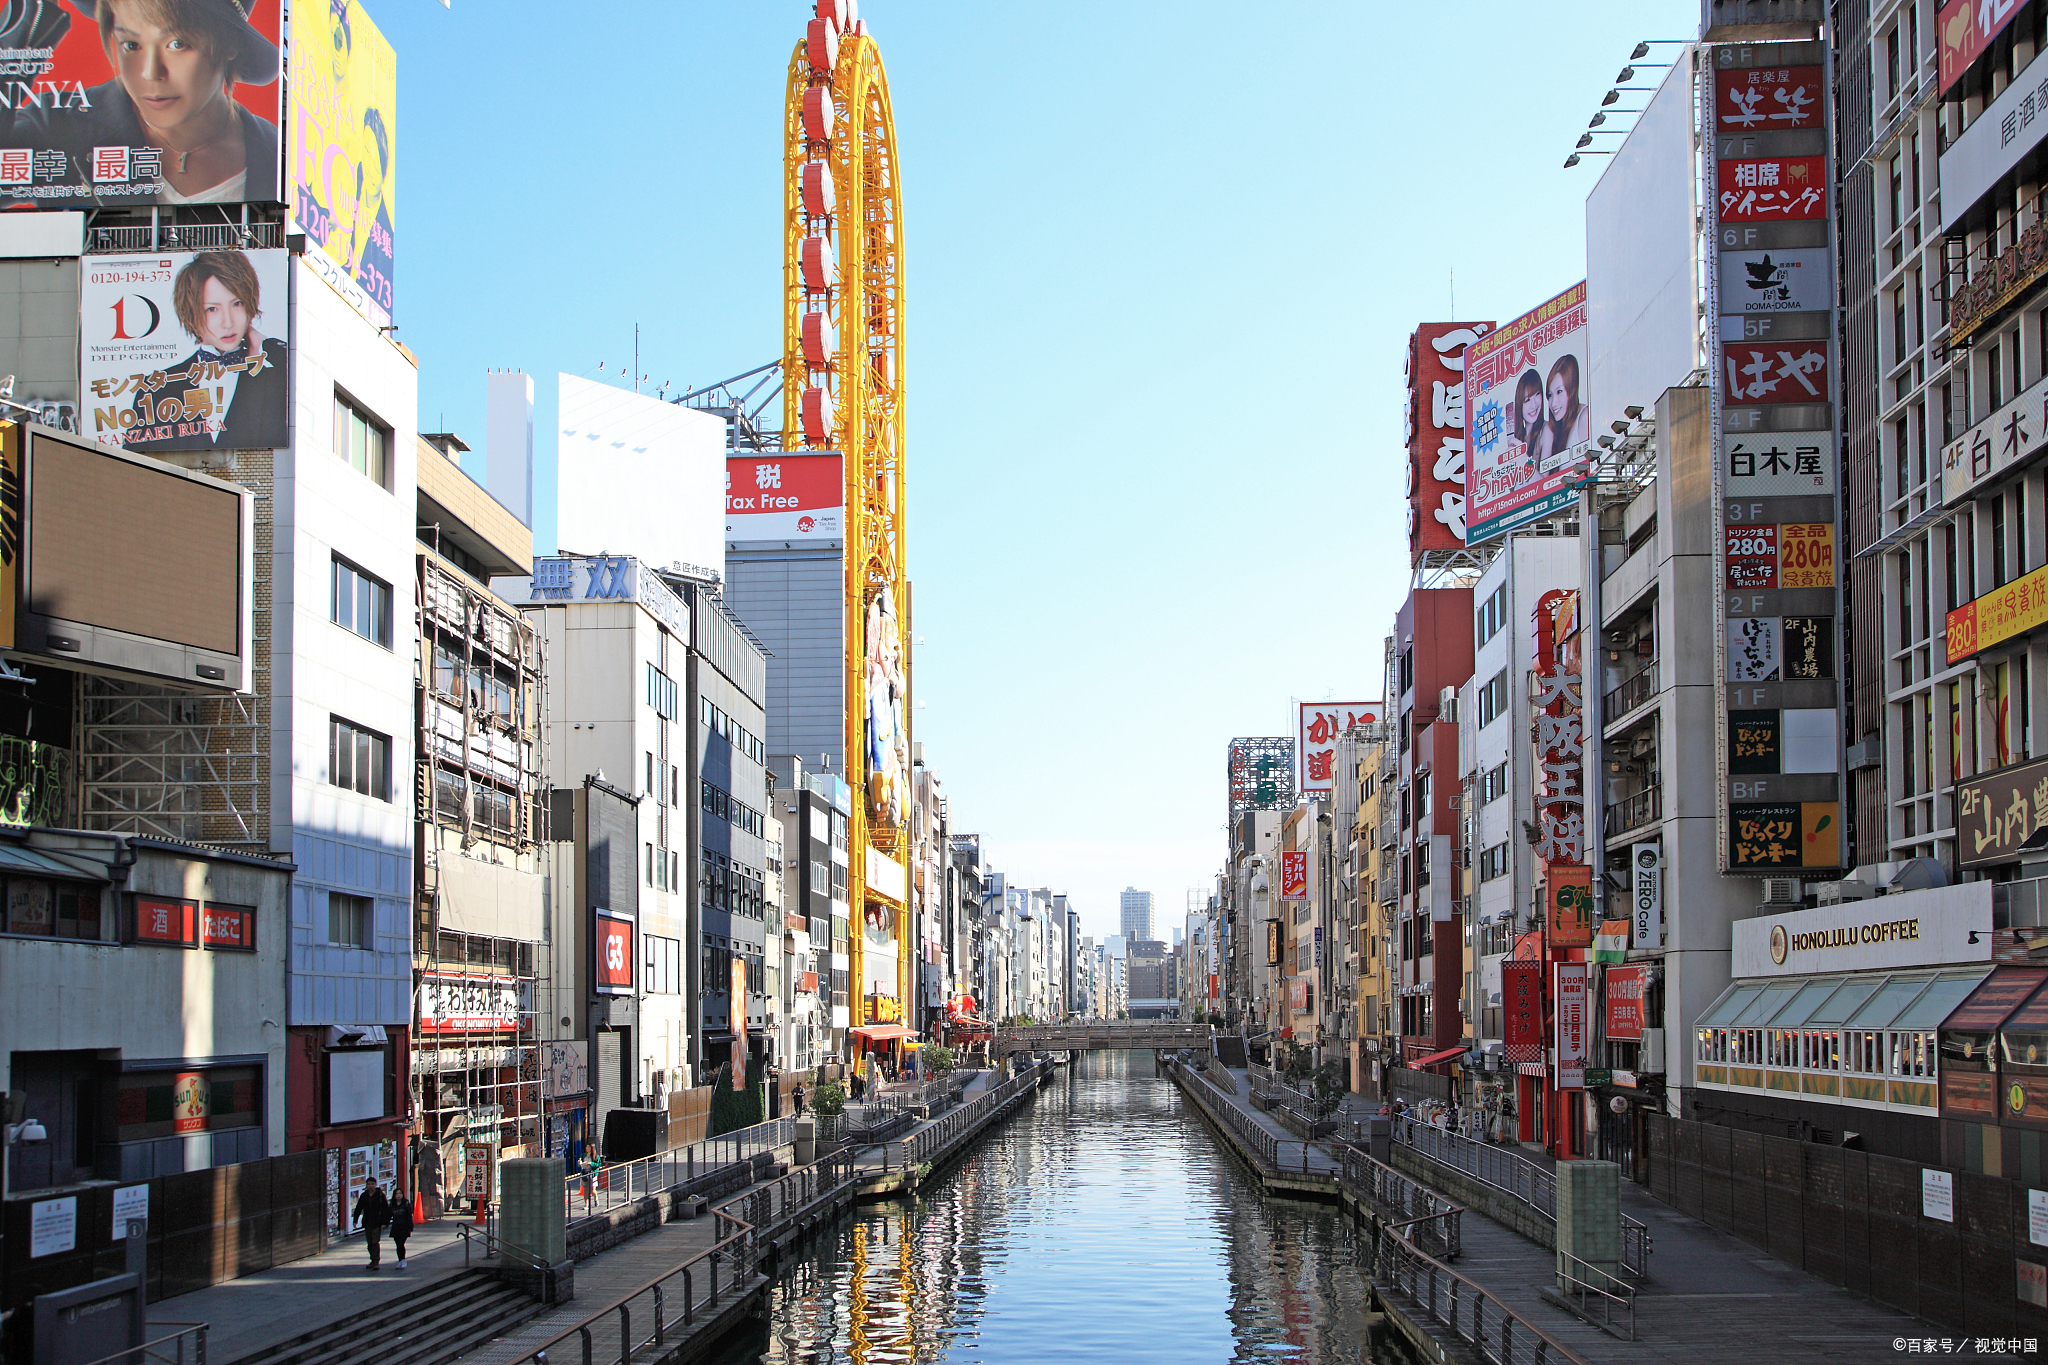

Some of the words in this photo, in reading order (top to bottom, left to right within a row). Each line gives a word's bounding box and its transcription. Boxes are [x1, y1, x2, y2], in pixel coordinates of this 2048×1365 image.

[1747, 70, 1790, 84] 居楽屋
[0, 149, 67, 182] 最幸
[94, 147, 163, 182] 最高
[1735, 162, 1780, 187] 相席
[94, 183, 165, 197] のホストクラブ
[1720, 187, 1825, 217] ダイニング
[91, 270, 172, 284] 0120-194-373
[1745, 301, 1802, 311] DOMA-DOMA
[1745, 319, 1772, 337] 5F
[91, 354, 127, 362] DEEP
[129, 352, 178, 360] GROUP
[124, 343, 177, 351] Entertainment
[90, 351, 268, 399] モンスターグループ
[1472, 336, 1537, 397] 高収入
[1726, 349, 1826, 400] はや
[94, 386, 224, 432] No.1の男!
[98, 424, 174, 446] KANZAKI
[178, 419, 227, 437] RUKA
[1730, 443, 1824, 477] 白木屋
[1945, 441, 1964, 471] 4F
[761, 493, 799, 509] Free
[1477, 486, 1539, 519] http://15navi.com/
[1728, 528, 1774, 537] ドリンク全品
[1785, 525, 1827, 538] 全品
[1727, 538, 1776, 556] 280円
[1781, 539, 1832, 569] 280円
[673, 560, 719, 578] 意匠作成中
[1730, 565, 1773, 579] 居心伝
[1782, 570, 1833, 587] 鳥貴族
[2004, 574, 2046, 623] 鳥貴族
[1785, 619, 1800, 630] 2F
[1947, 619, 1977, 655] 280円
[1802, 618, 1819, 678] 山内農場
[1737, 728, 1772, 743] びっくり
[1531, 664, 1583, 862] 大阪王将
[1735, 743, 1774, 757] ドンキー
[1732, 781, 1767, 799] B1F
[1961, 788, 1981, 816] 2F
[1738, 819, 1793, 842] びっくり
[1736, 841, 1797, 864] ドンキー
[1285, 859, 1294, 888] ドラッグ
[1294, 854, 1304, 881] ツルハ
[1639, 872, 1652, 910] ZERO
[152, 908, 168, 933] 酒
[204, 914, 240, 939] たばこ
[1639, 911, 1649, 939] cafe
[1792, 926, 1859, 952] HONOLULU
[1861, 918, 1920, 944] COFFEE
[606, 934, 624, 971] G3
[1518, 972, 1531, 1034] 大阪みやげ
[1614, 1006, 1637, 1019] 三日月百子
[1571, 1003, 1581, 1052] 三日月百子
